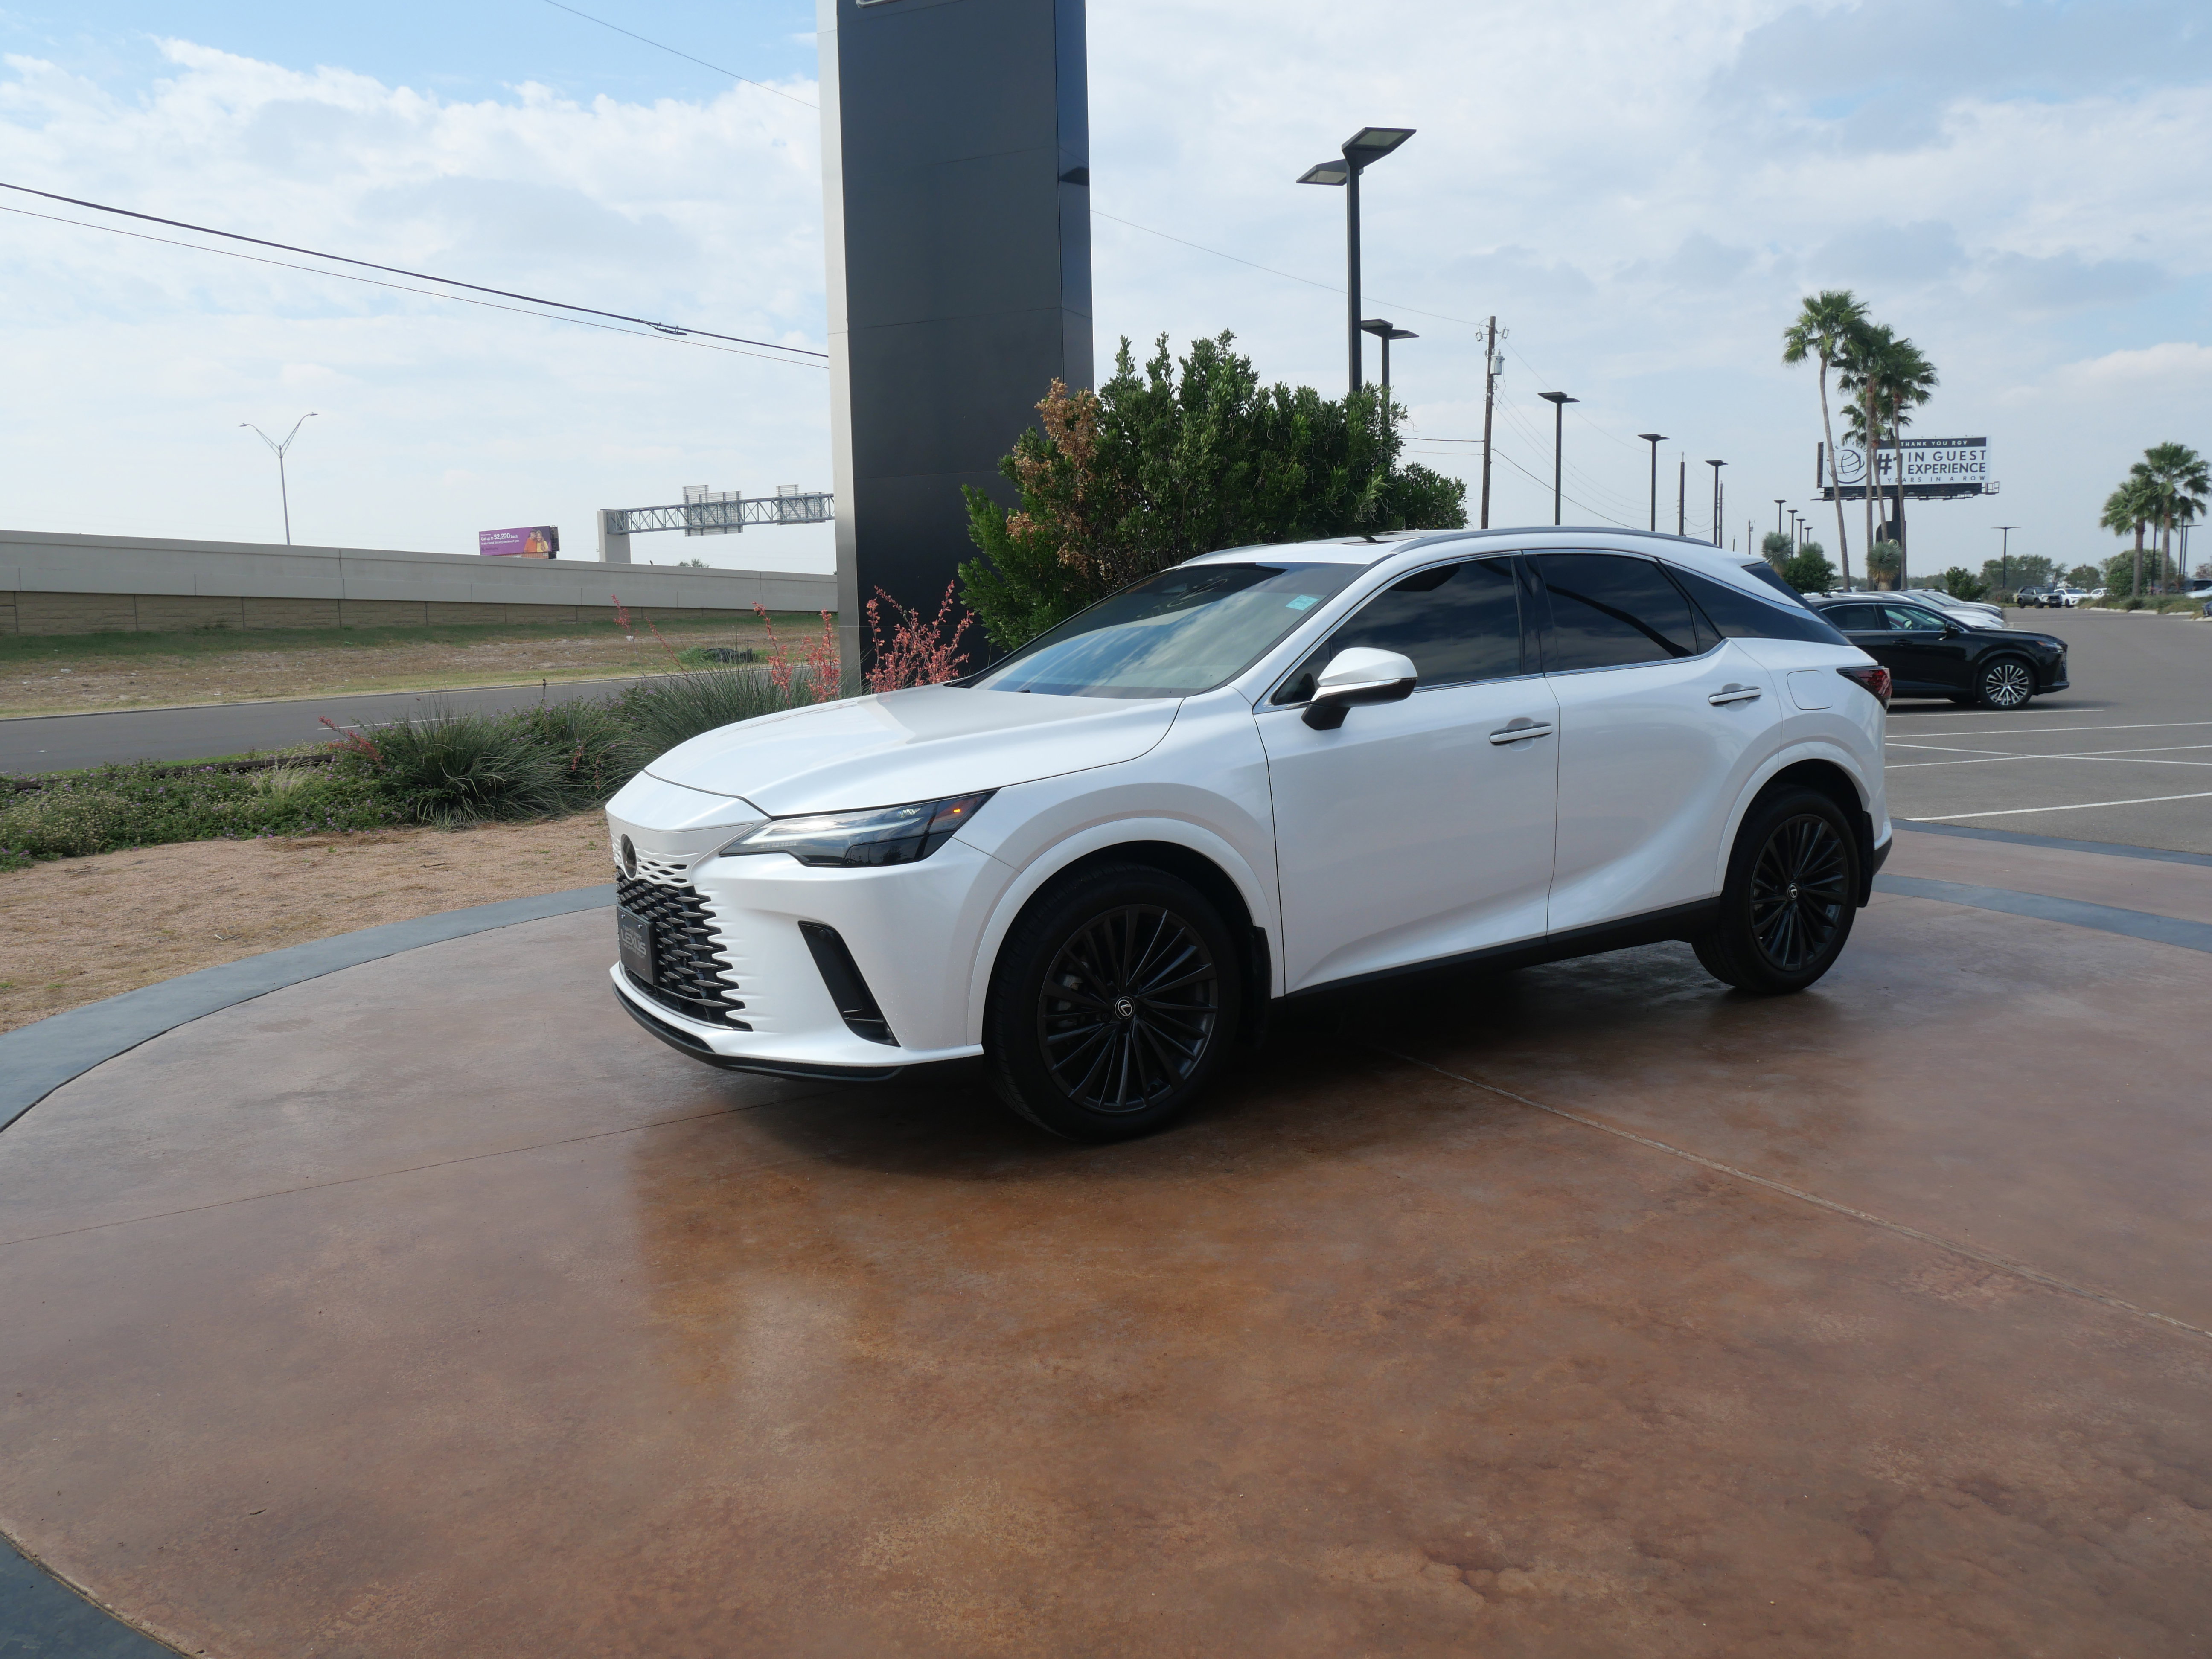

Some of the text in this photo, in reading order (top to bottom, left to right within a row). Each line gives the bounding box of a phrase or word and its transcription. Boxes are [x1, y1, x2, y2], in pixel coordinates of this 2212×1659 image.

[1908, 452, 1924, 462] IN
[1933, 450, 1986, 461] GUEST
[1908, 463, 1986, 474] EXPERIENCE
[621, 928, 646, 955] LEXUS
